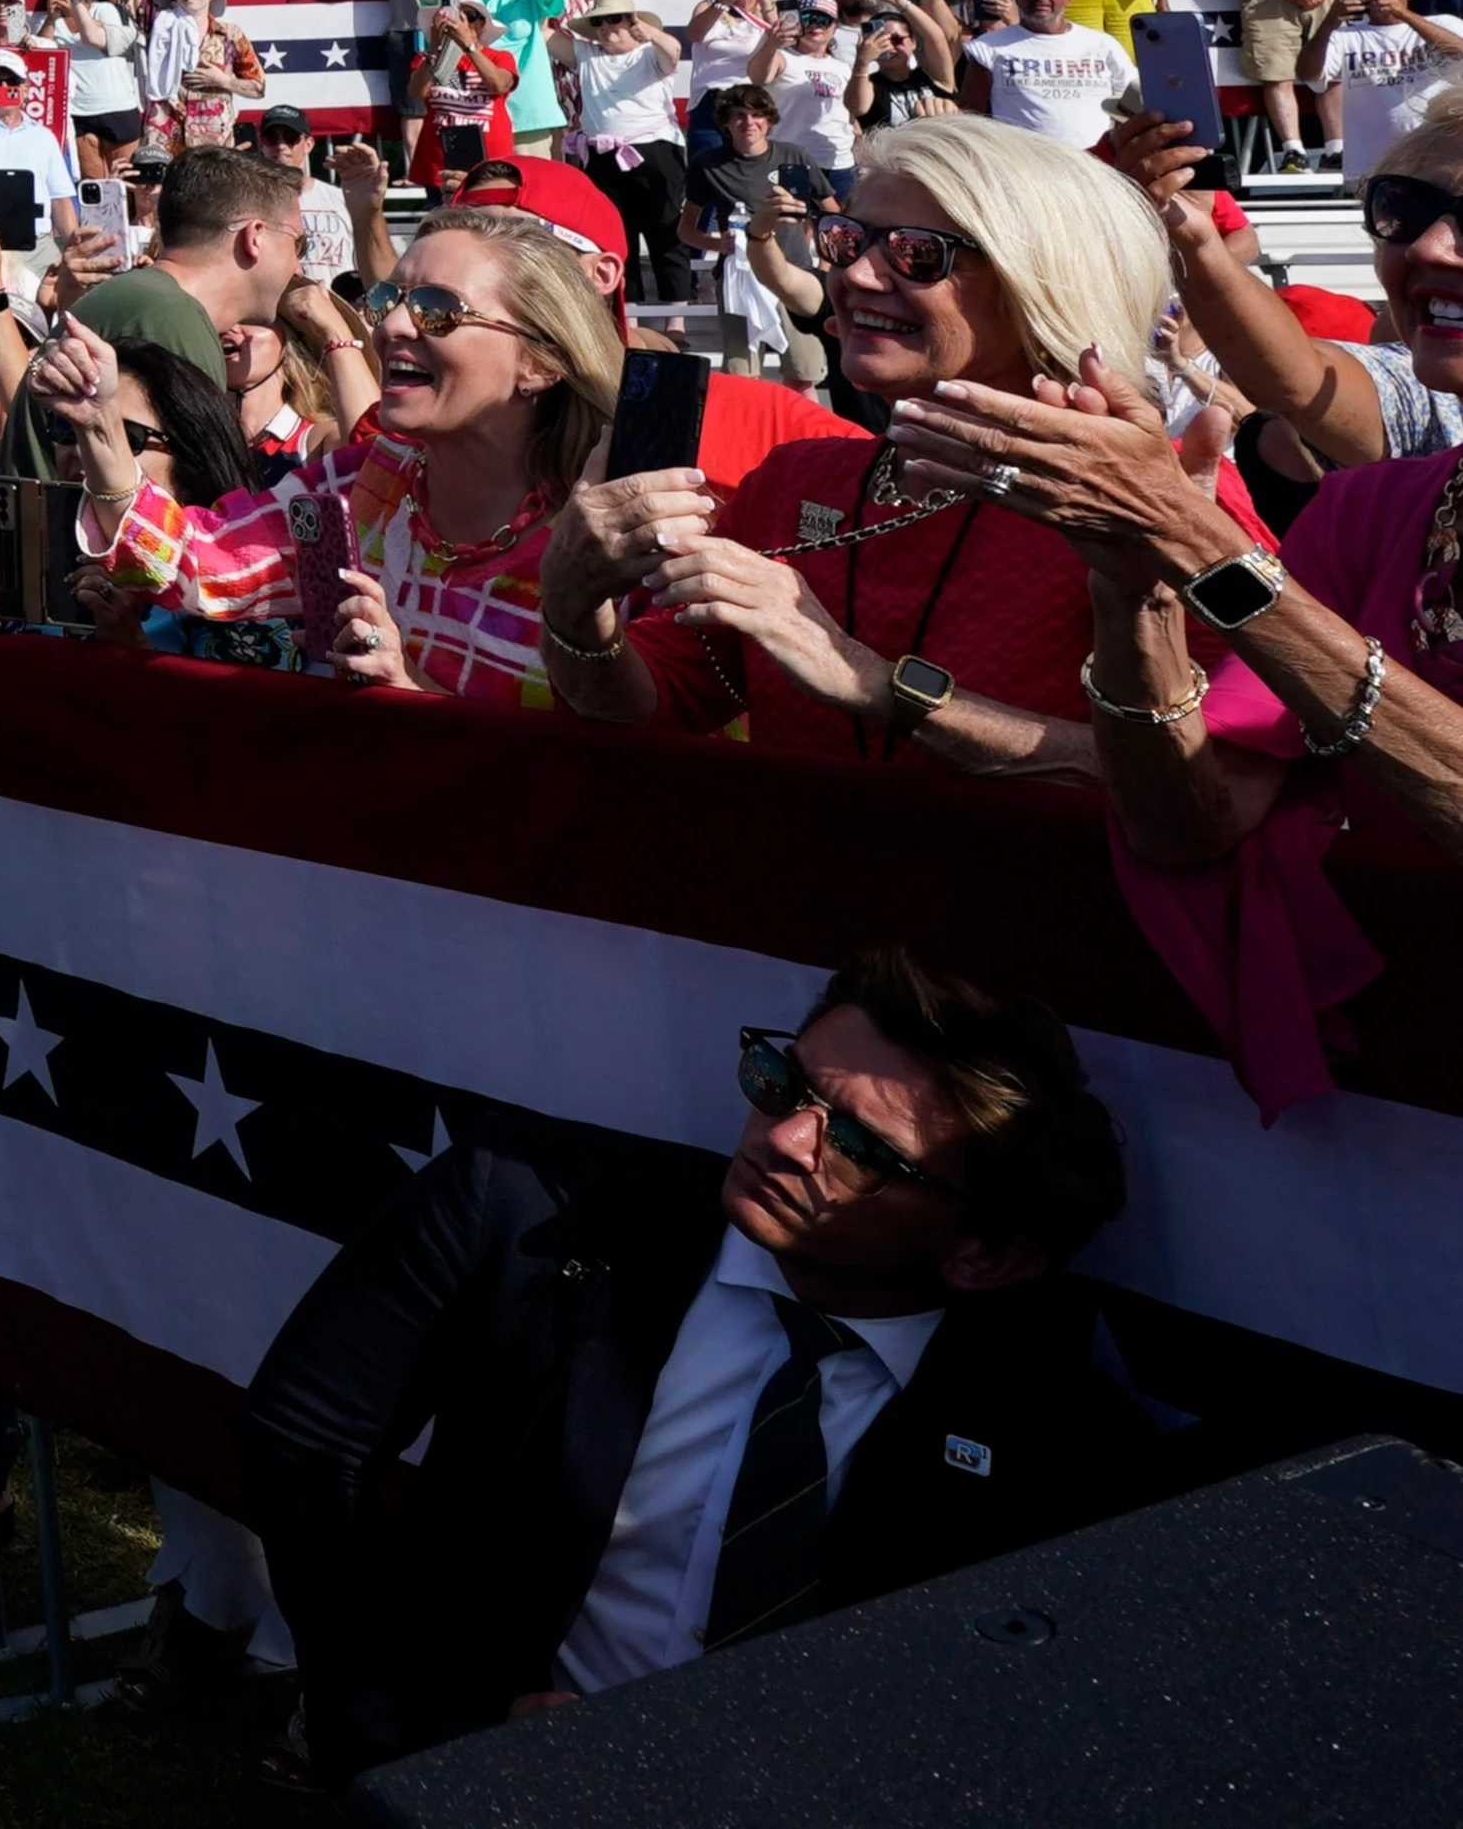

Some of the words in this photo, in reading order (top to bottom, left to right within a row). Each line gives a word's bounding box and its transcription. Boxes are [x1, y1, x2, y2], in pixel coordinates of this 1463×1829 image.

[1003, 57, 1106, 78] TRUMP
[1035, 78, 1084, 88] AMERICA
[26, 69, 46, 125] 024
[1042, 88, 1081, 100] 2024
